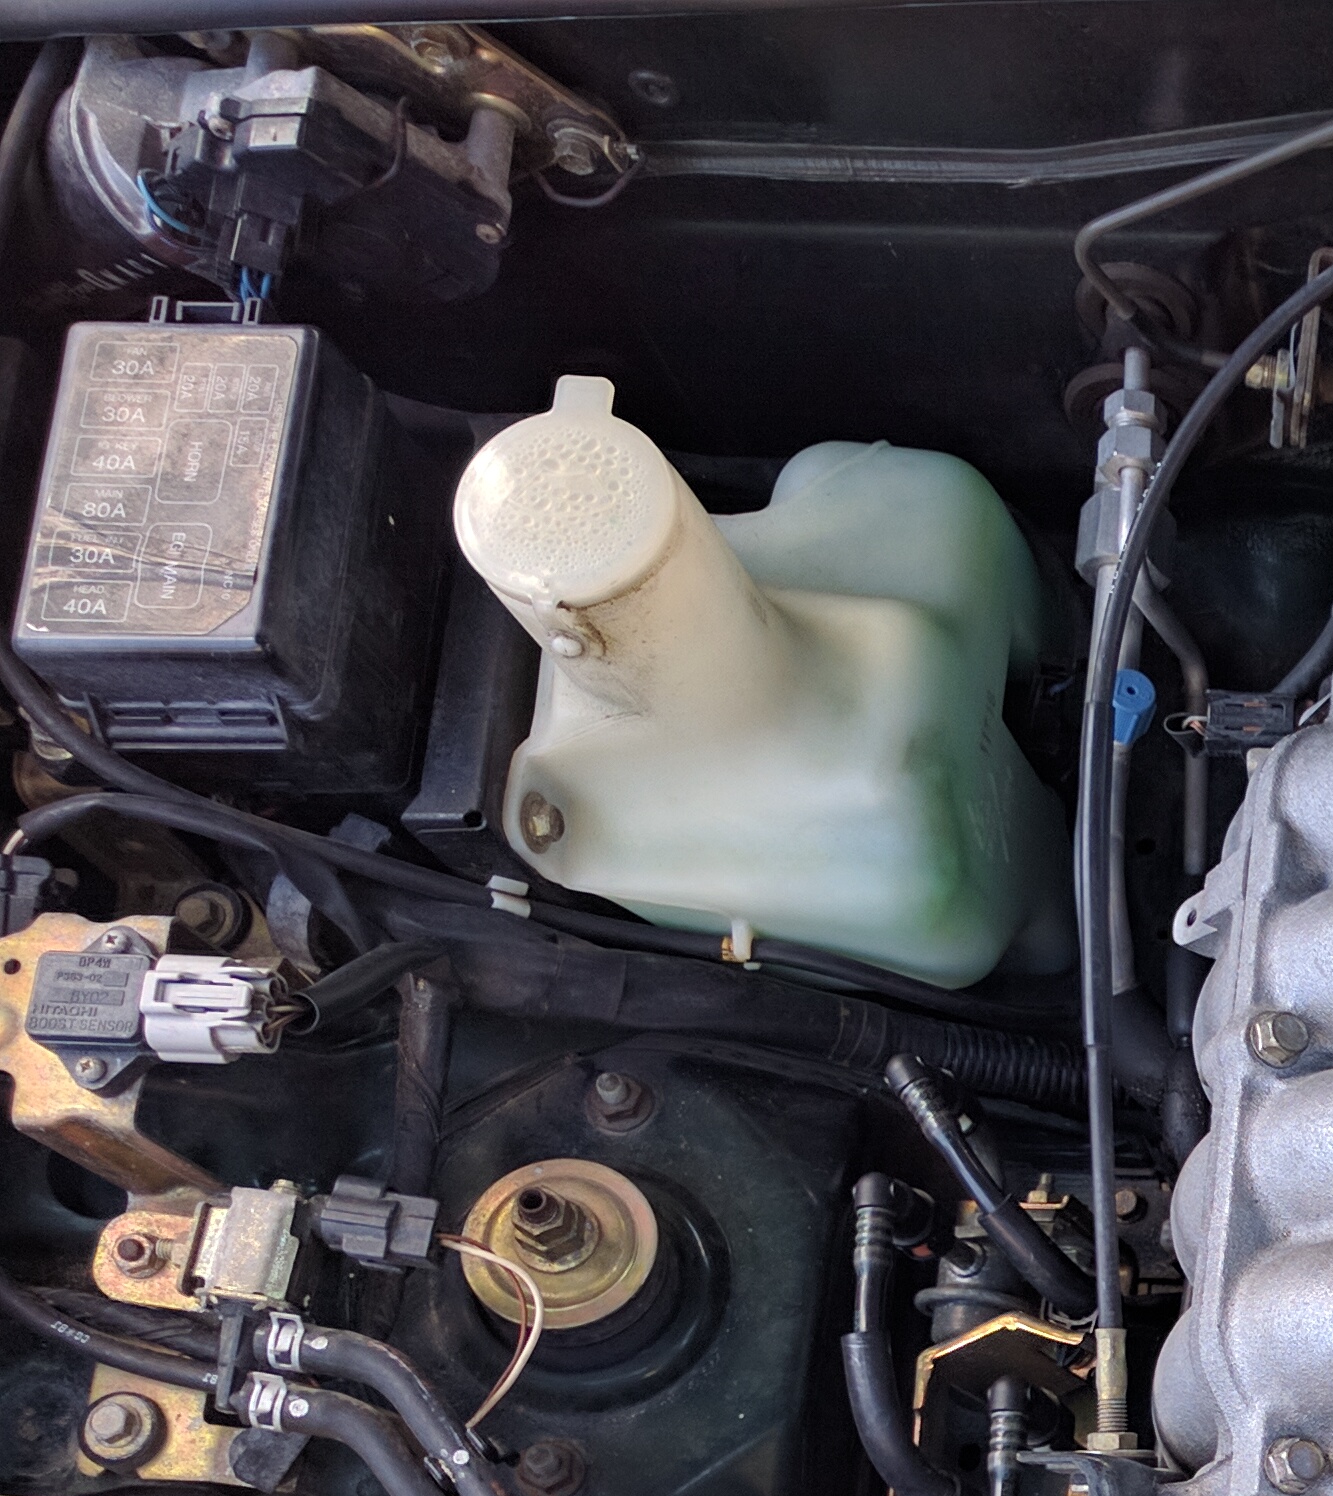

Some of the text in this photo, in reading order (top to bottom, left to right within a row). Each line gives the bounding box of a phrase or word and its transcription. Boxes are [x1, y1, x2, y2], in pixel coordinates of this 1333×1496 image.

[111, 360, 155, 376] 30A
[180, 375, 195, 400] 20A
[214, 376, 228, 400] 20A
[247, 376, 262, 401] 20A
[102, 406, 146, 423] 30A
[92, 455, 136, 470] 40A
[184, 441, 203, 482] HORN
[82, 502, 126, 518] 80A
[70, 547, 115, 564] 30A
[160, 561, 179, 600] MAIN
[73, 585, 105, 594] HEAD
[63, 599, 107, 615] 40A
[31, 1003, 98, 1017] HITACHI
[28, 1016, 134, 1032] BOOST SENSOR
